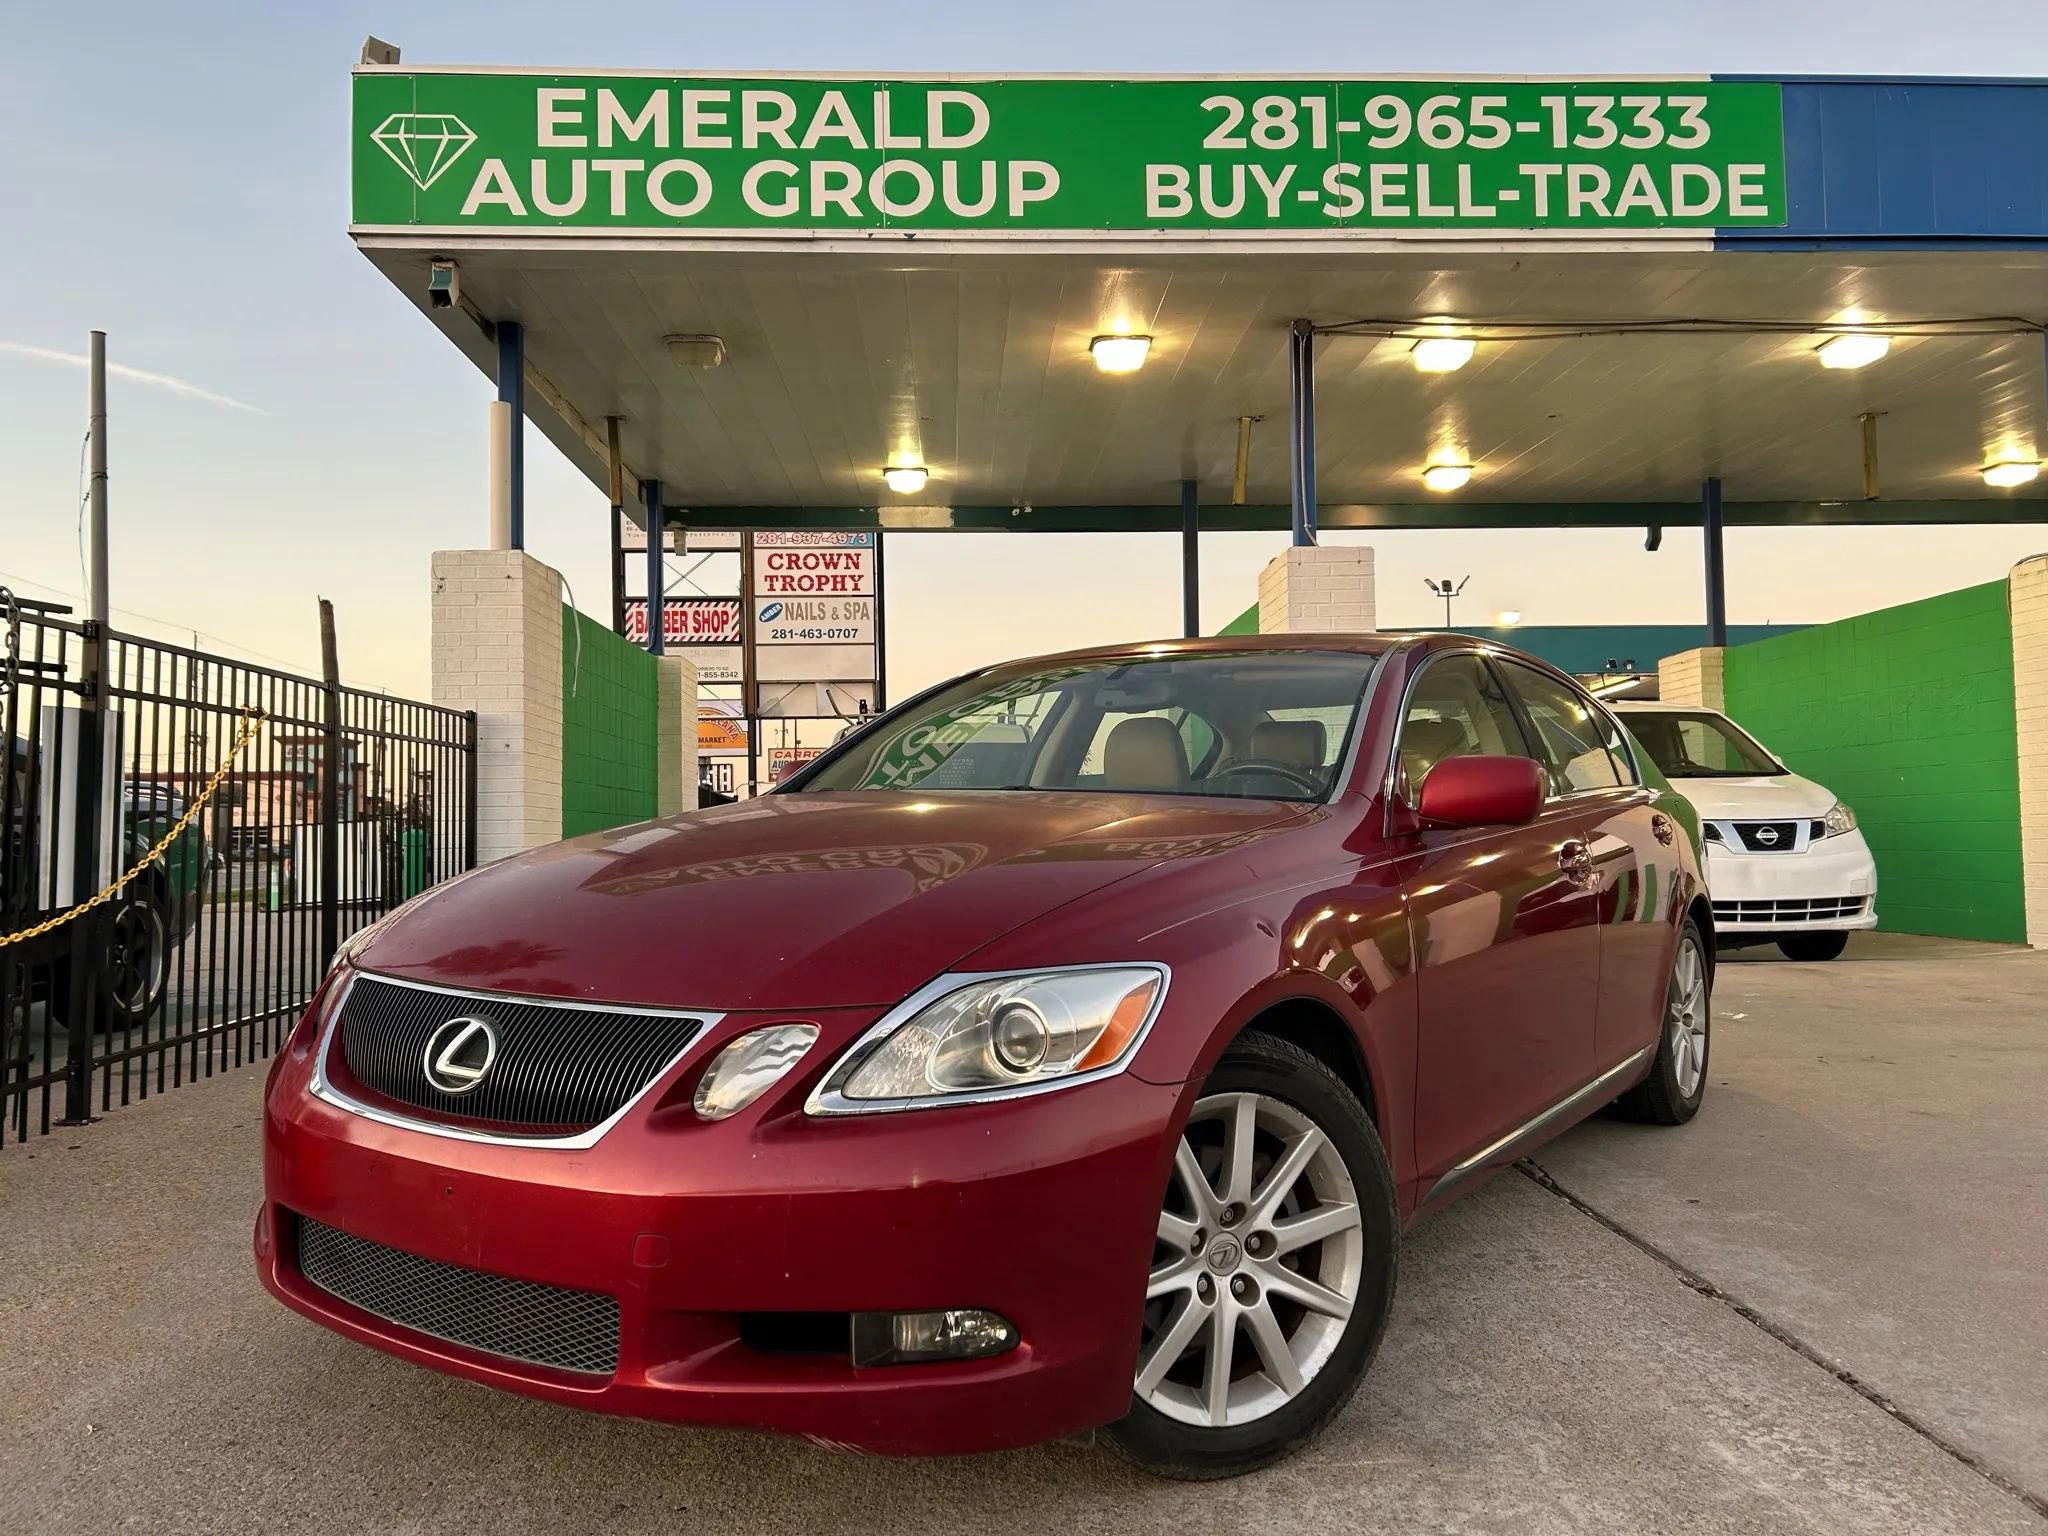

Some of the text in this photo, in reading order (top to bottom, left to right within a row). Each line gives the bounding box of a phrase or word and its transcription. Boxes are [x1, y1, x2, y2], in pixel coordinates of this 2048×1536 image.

[536, 87, 991, 150] EMERALD
[1200, 94, 1712, 151] 281-965-1333
[460, 158, 1061, 218] AUTO GROUP
[1144, 163, 1769, 219] BUY-SELL-TRADE
[756, 532, 868, 545] 281-937-4973
[767, 552, 862, 571] CROWN
[764, 574, 864, 592] TROPHY
[635, 609, 730, 634] BBER SHOP
[760, 601, 870, 622] AMBER NAILS & SPA
[771, 628, 859, 639] 281-463-0707
